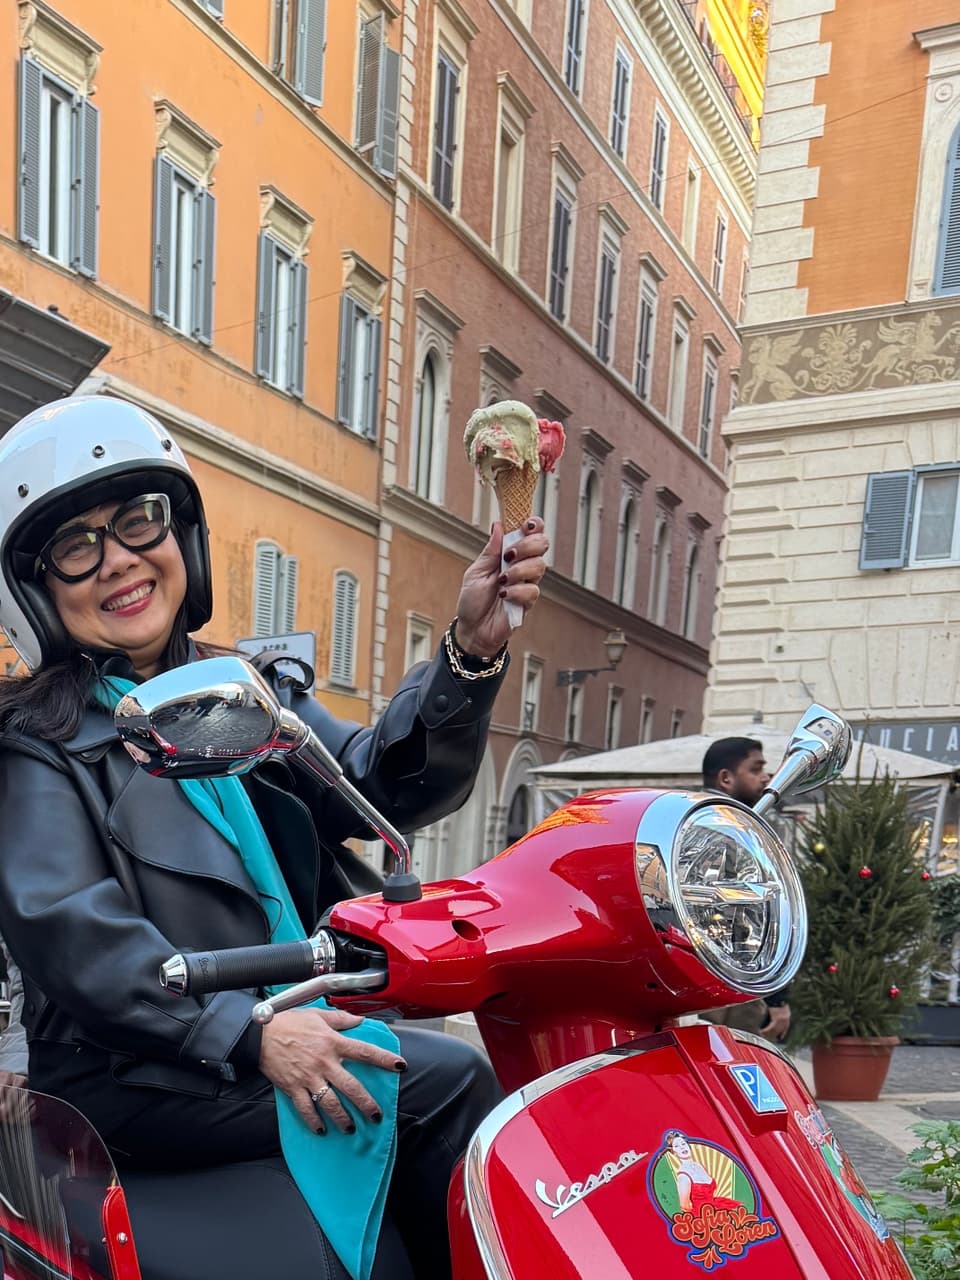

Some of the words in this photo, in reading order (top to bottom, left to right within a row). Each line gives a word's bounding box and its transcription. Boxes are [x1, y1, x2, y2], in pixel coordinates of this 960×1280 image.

[535, 1149, 649, 1219] Vespa
[672, 1203, 732, 1249] Sofia
[710, 1220, 777, 1256] Loren
